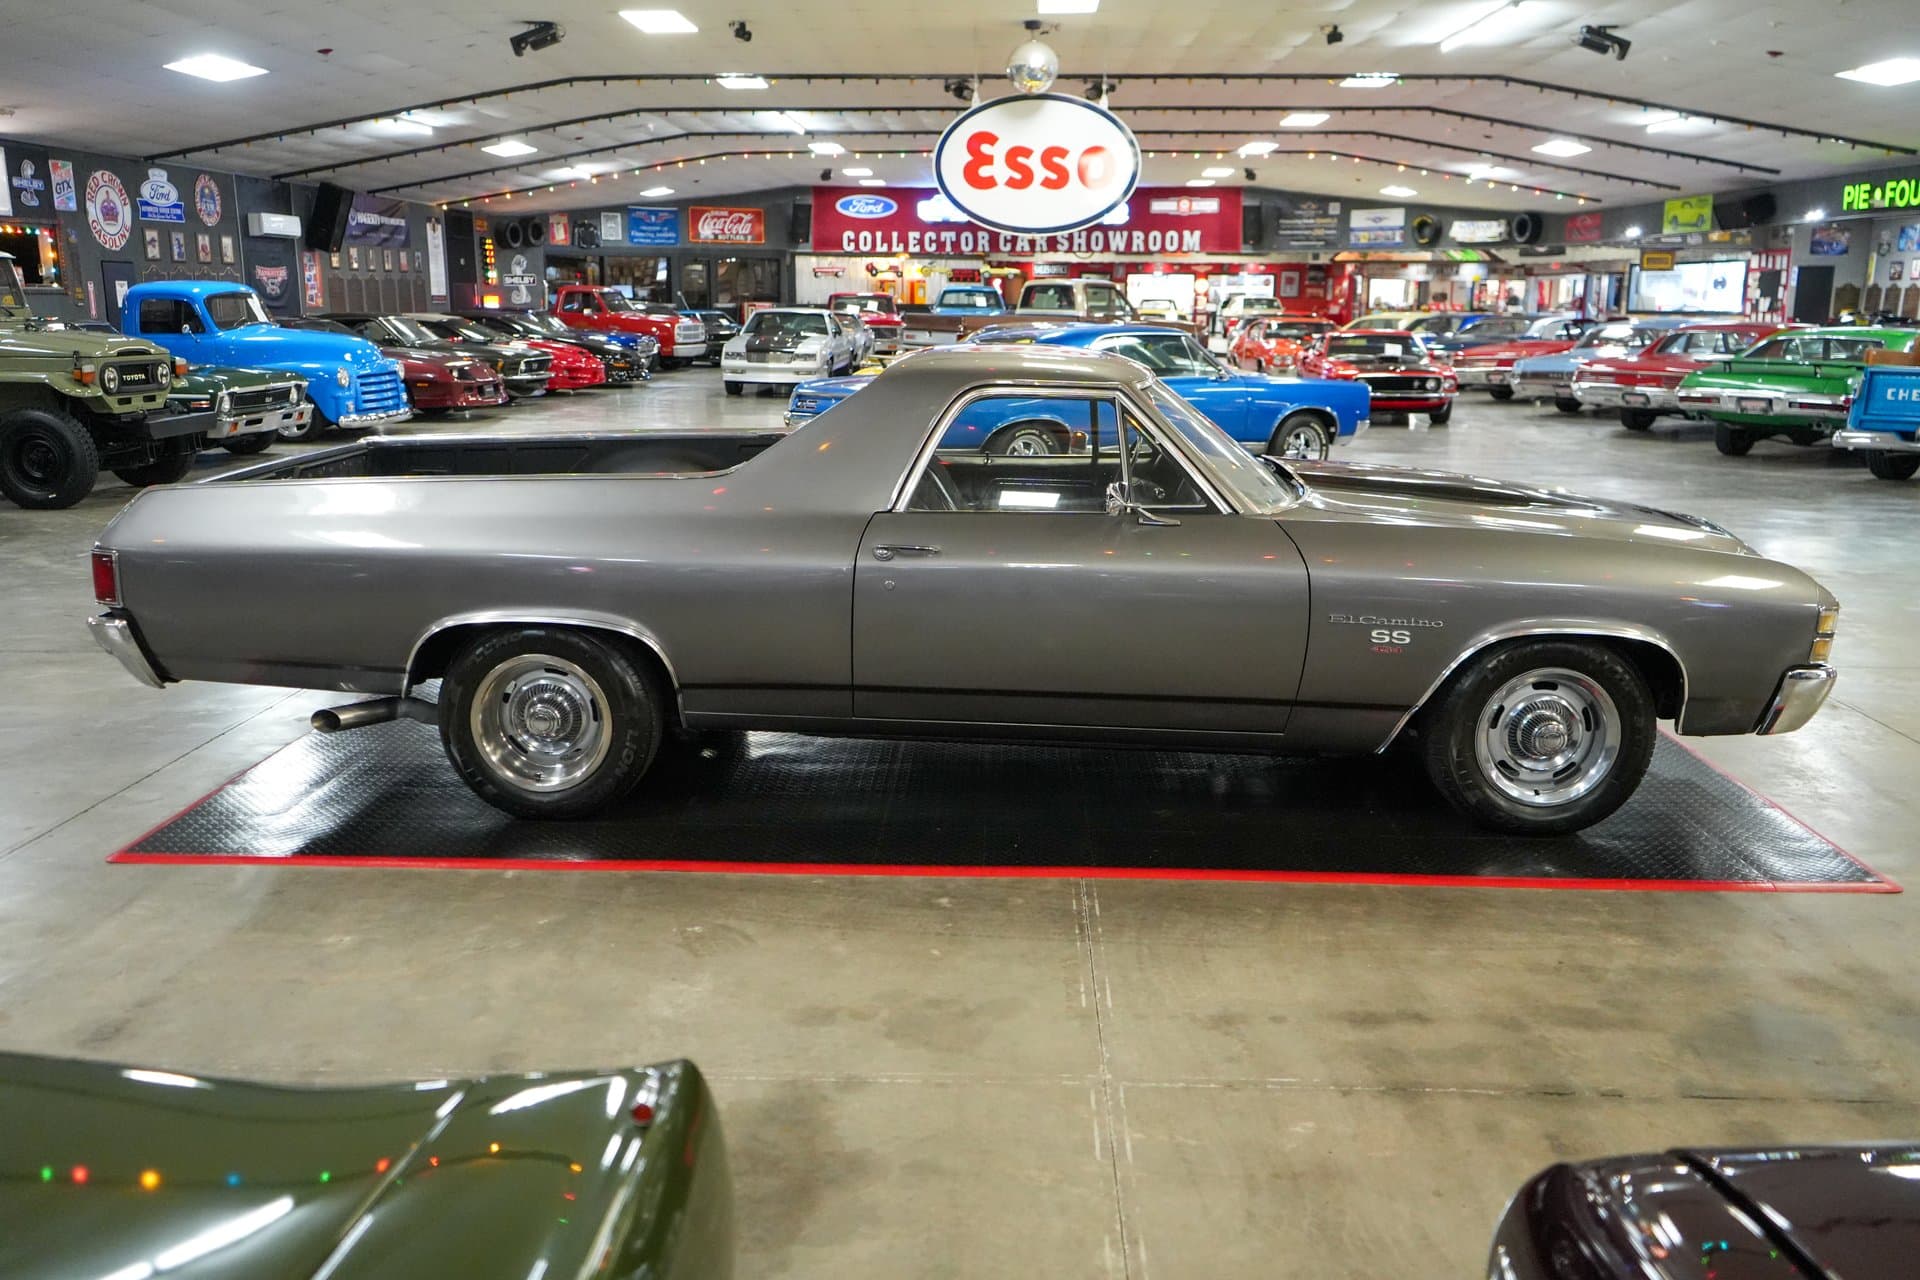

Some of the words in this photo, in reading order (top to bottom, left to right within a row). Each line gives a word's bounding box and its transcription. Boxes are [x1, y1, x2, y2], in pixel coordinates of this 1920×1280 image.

[55, 180, 73, 195] GTX
[87, 176, 99, 203] RED
[101, 172, 128, 206] CROWN
[149, 183, 171, 201] Ford
[849, 199, 884, 213] Ford
[1843, 183, 1871, 211] PIE
[91, 219, 130, 249] GASOLINE
[842, 230, 990, 253] COLLECTOR
[999, 233, 1047, 253] CAR
[1056, 230, 1202, 252] SHOWROOM
[1887, 388, 1920, 401] CHE
[1370, 629, 1411, 644] SS
